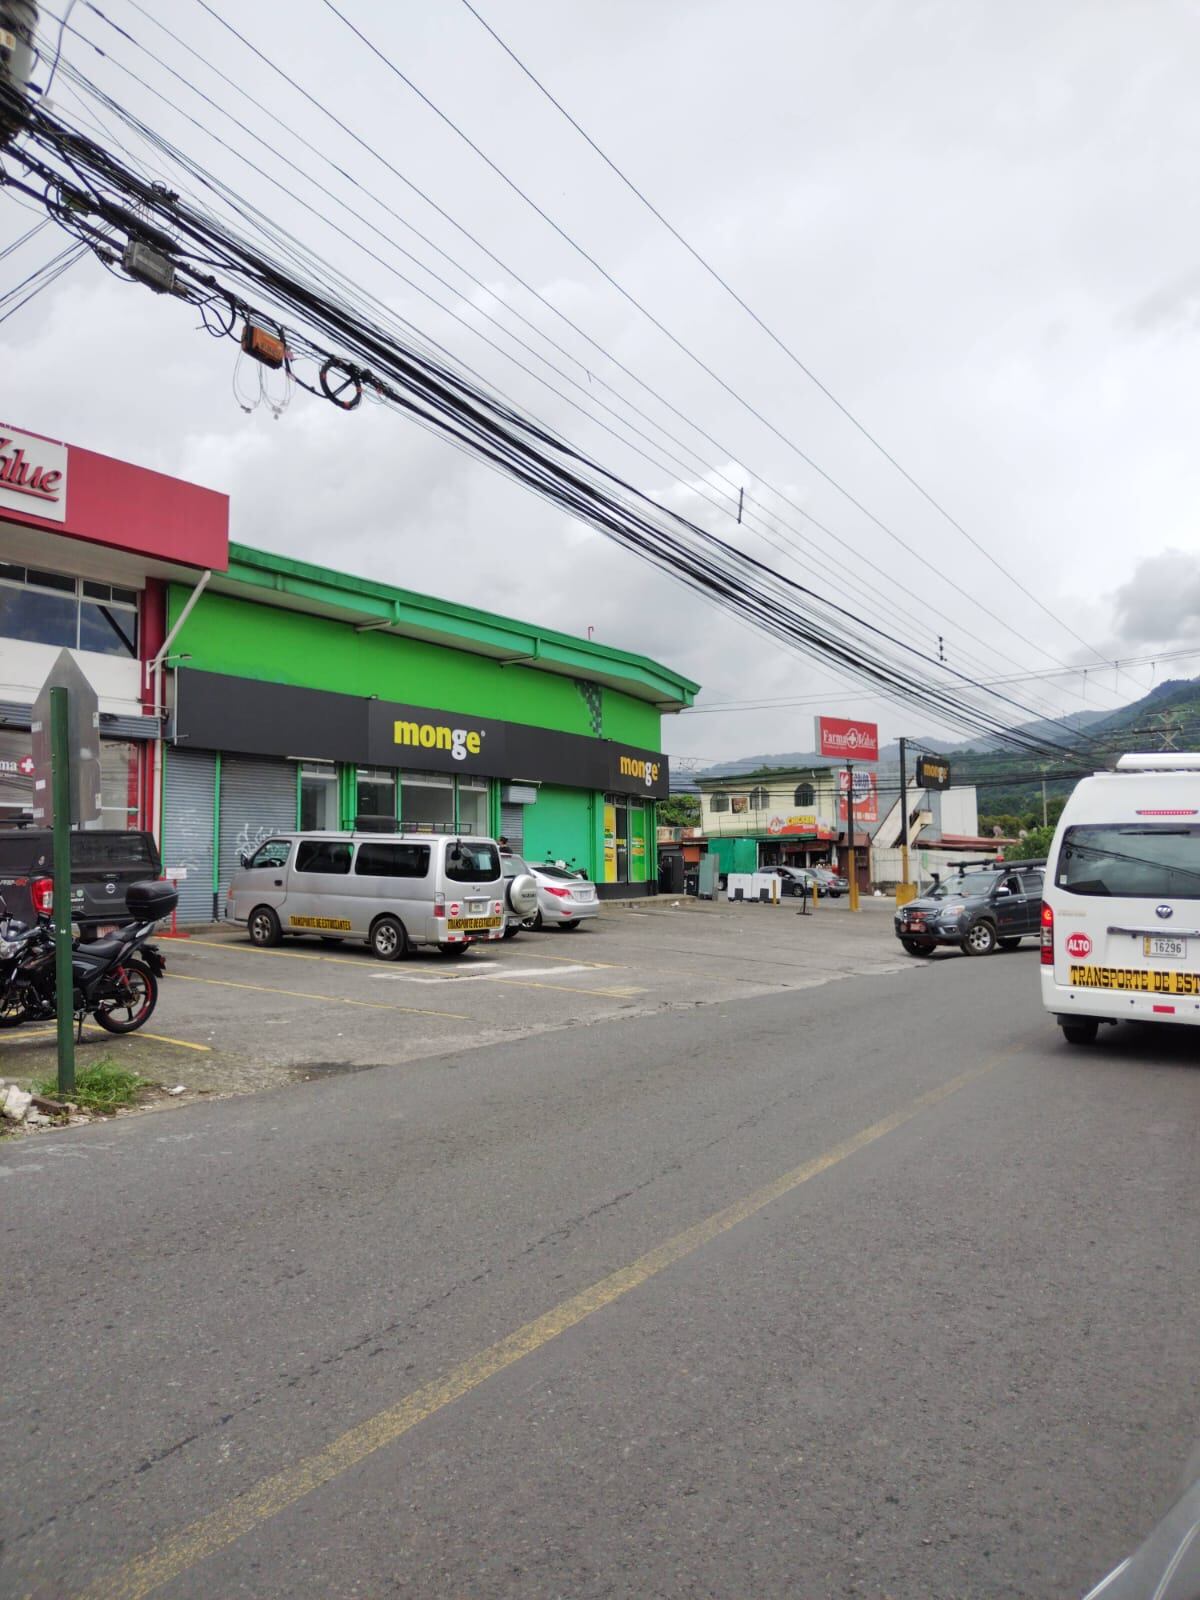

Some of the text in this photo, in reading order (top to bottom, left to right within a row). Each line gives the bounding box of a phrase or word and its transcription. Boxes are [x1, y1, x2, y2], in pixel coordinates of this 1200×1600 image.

[394, 720, 481, 760] monge
[823, 729, 848, 746] Farma
[620, 756, 659, 787] monge
[923, 764, 948, 783] monge
[1068, 939, 1090, 952] ALTO
[1154, 942, 1182, 953] 16296
[1071, 965, 1148, 990] TRANSPORTE
[1154, 971, 1169, 991] DE
